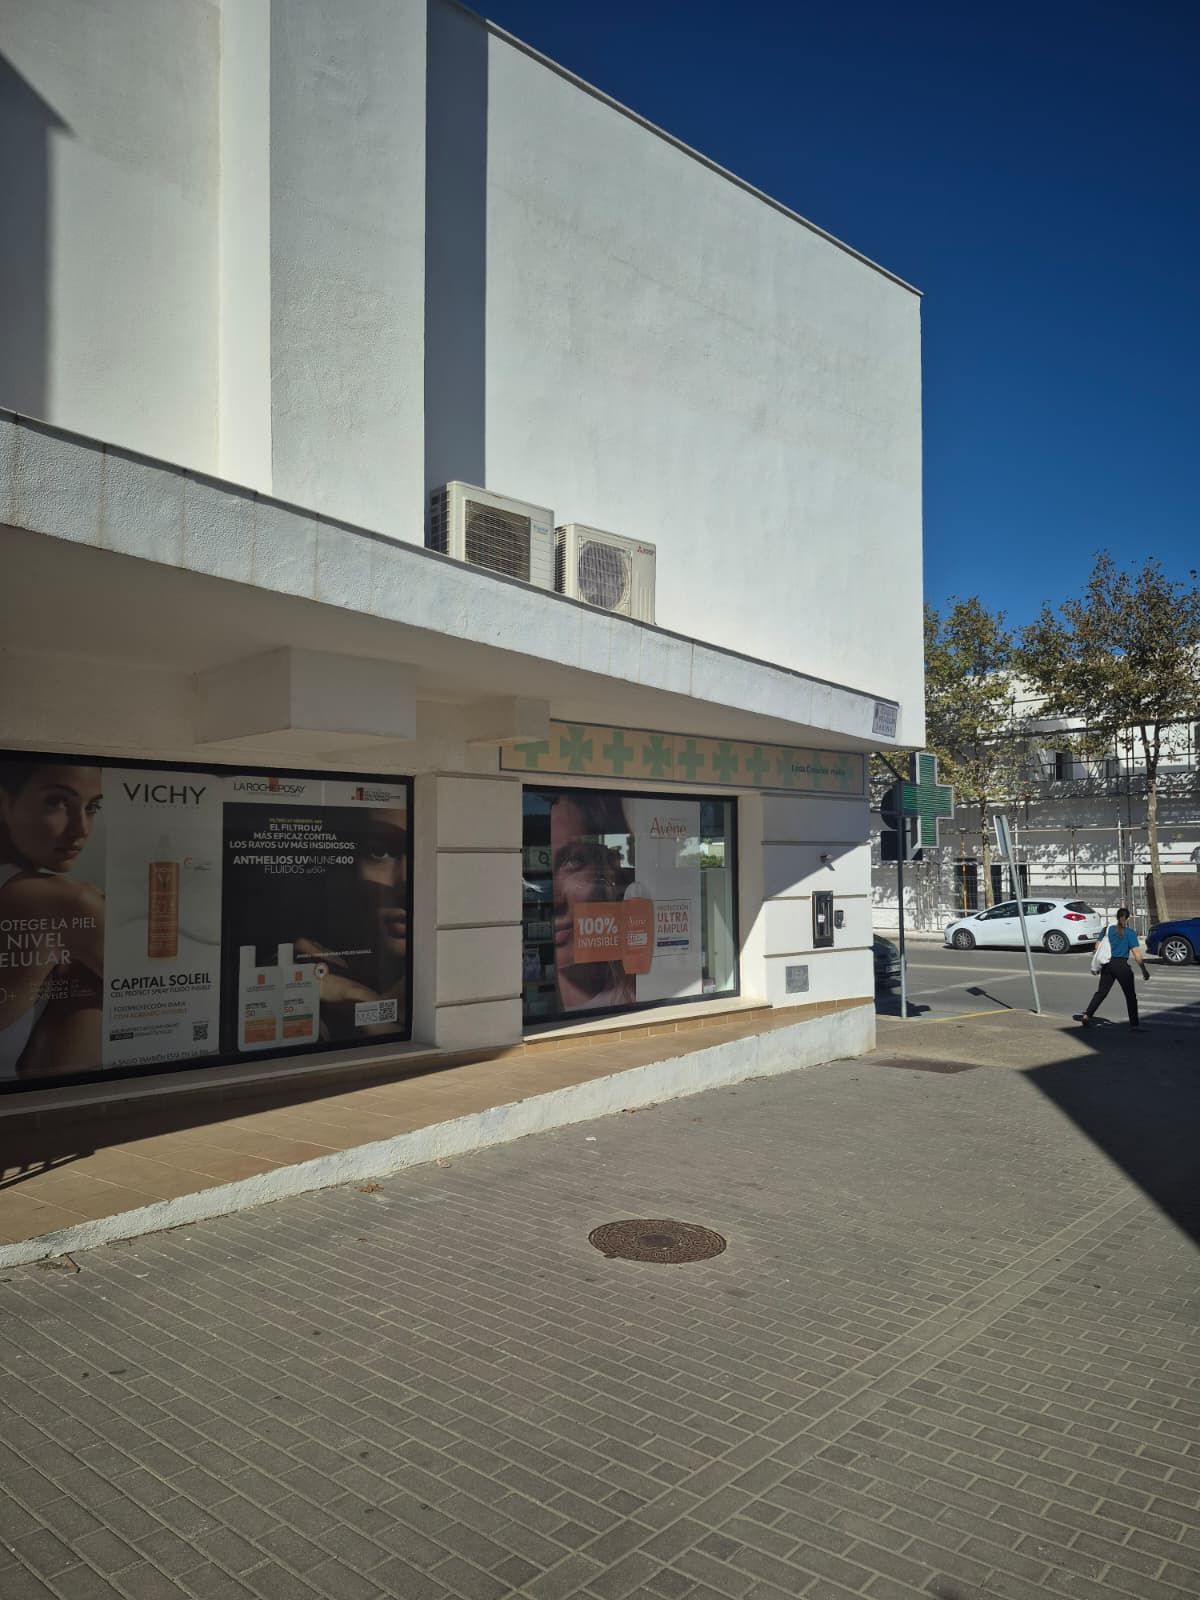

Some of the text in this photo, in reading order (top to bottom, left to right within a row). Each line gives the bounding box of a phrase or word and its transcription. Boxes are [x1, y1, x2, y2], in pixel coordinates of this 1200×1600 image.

[122, 782, 207, 805] VICHY
[270, 823, 322, 832] EL FILTRO UV
[253, 830, 337, 842] MÁS EFICAZ CONTRA
[229, 840, 247, 849] LOS
[248, 841, 276, 850] RAYOS
[278, 841, 290, 850] UV
[290, 840, 308, 850] MÁS
[233, 855, 293, 865] ANTHELIOS
[264, 865, 305, 875] FLUIDOS
[51, 917, 68, 930] LA
[72, 916, 97, 929] PIEL
[657, 911, 689, 923] ULTRA
[577, 917, 619, 936] 100%
[657, 923, 689, 934] AMPLIA
[7, 932, 65, 951] NIVEL
[578, 936, 619, 949] INVISIBLE
[111, 976, 167, 991] CAPITAL
[168, 972, 211, 987] SOLEIL
